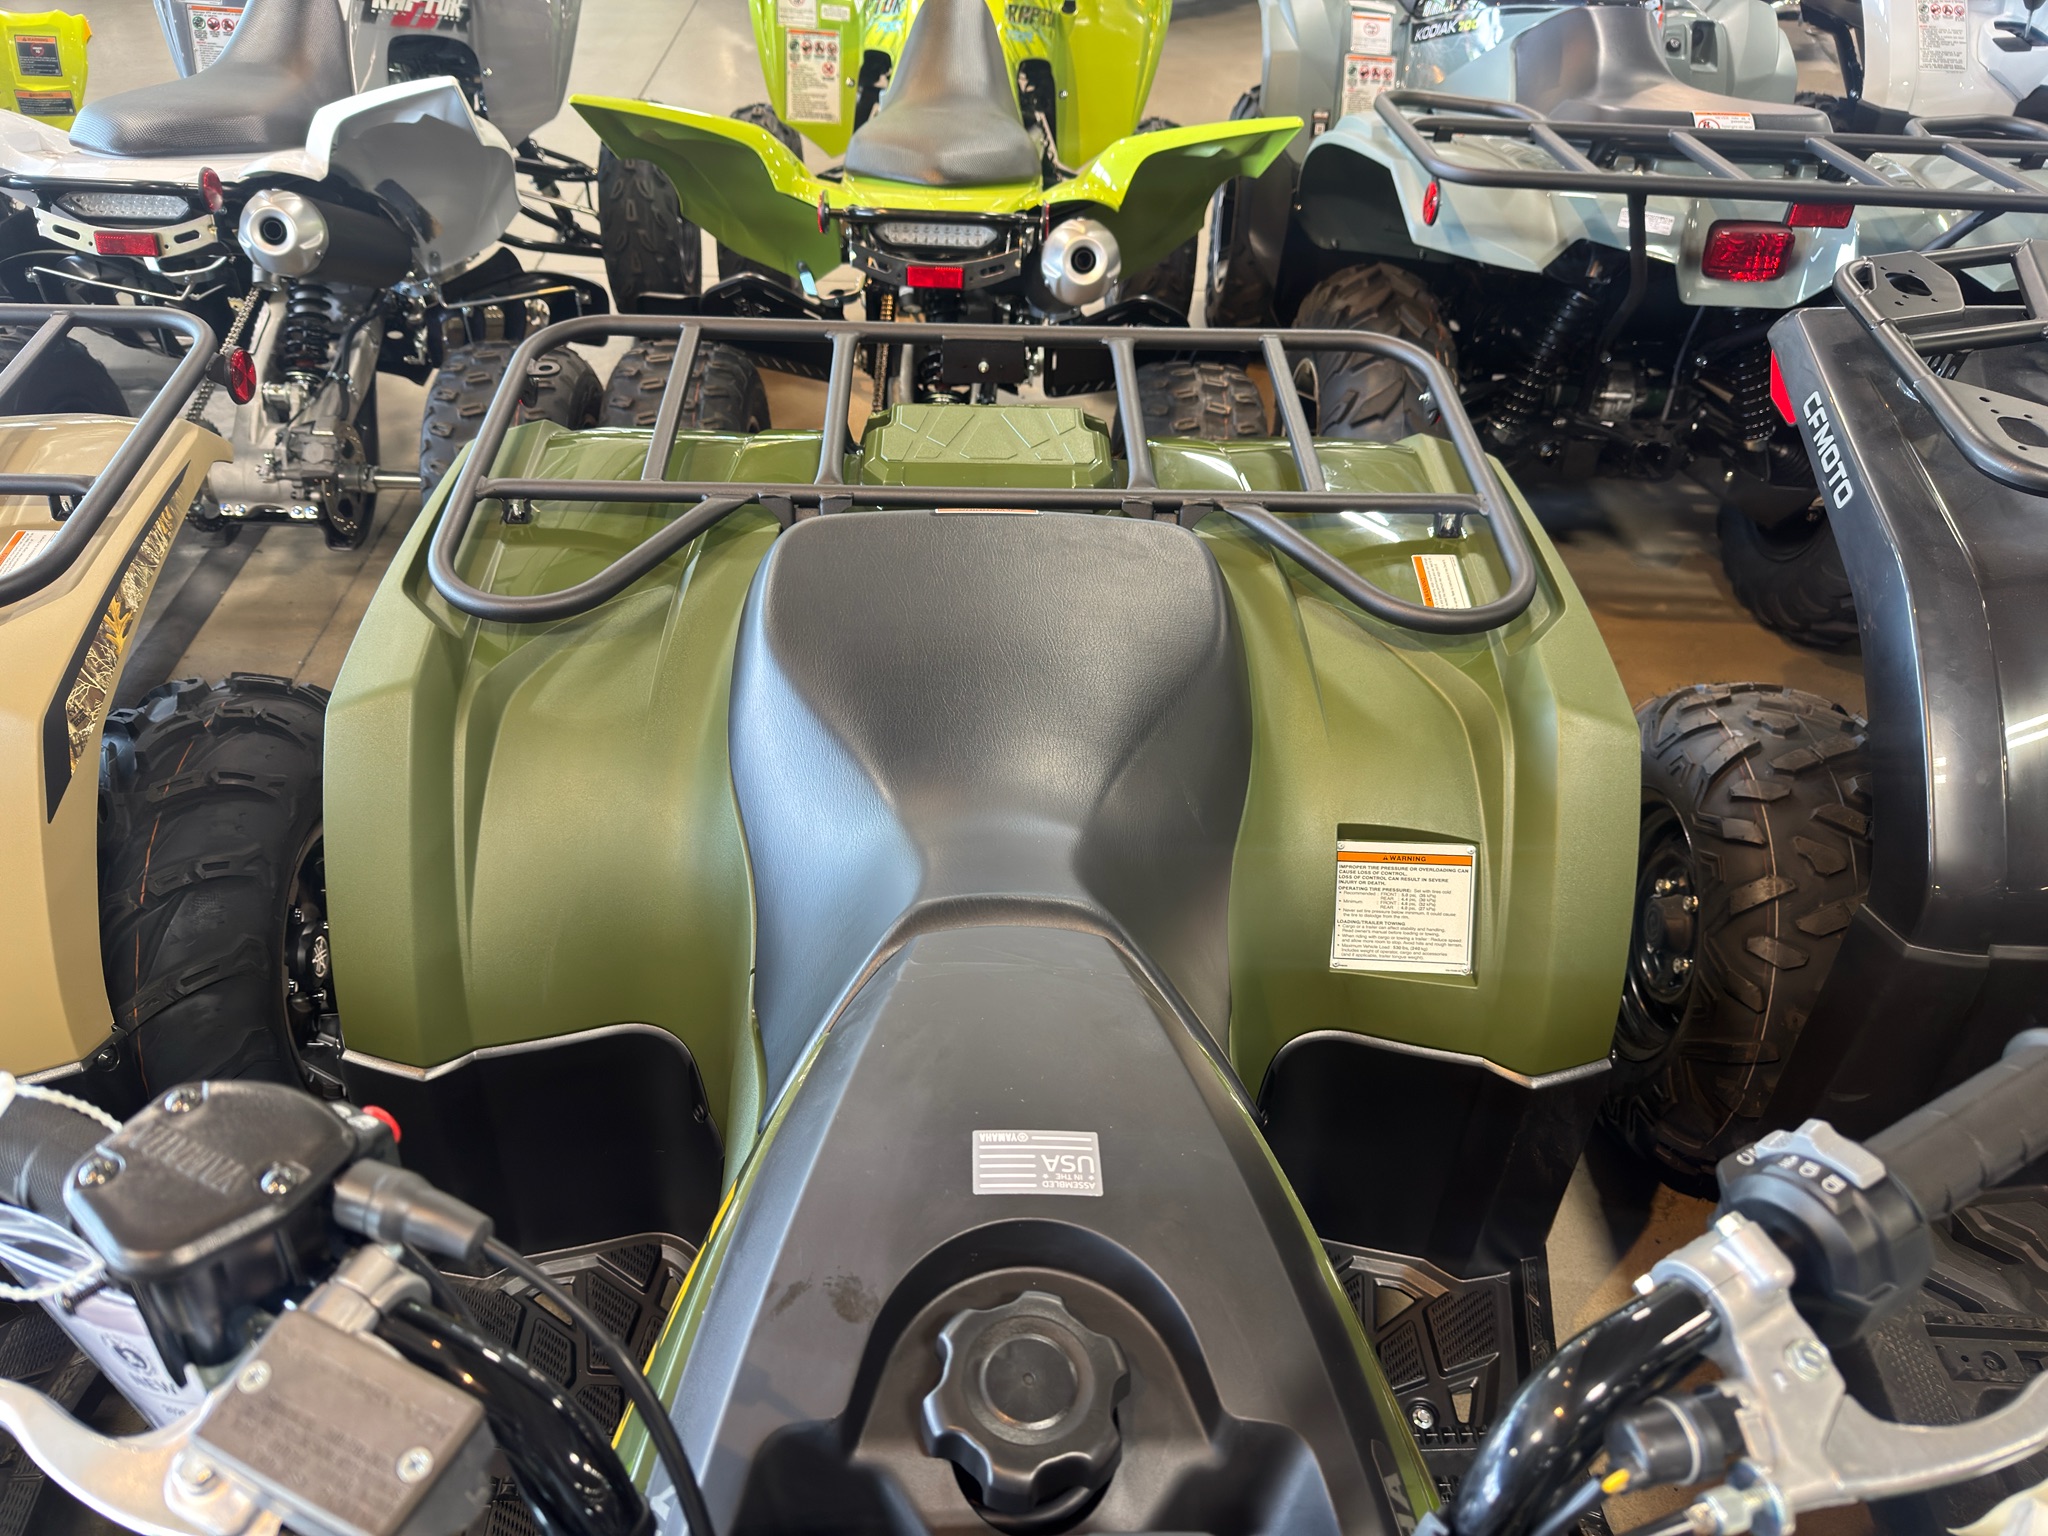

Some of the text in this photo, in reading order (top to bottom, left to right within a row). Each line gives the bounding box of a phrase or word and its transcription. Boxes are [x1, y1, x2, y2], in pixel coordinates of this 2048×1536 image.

[1414, 19, 1458, 42] KODIAK
[1803, 390, 1853, 509] CFMOTO
[979, 1132, 1017, 1143] YAMAHA
[1041, 1154, 1095, 1174] USA
[1042, 1180, 1096, 1190] ASSEMBLED
